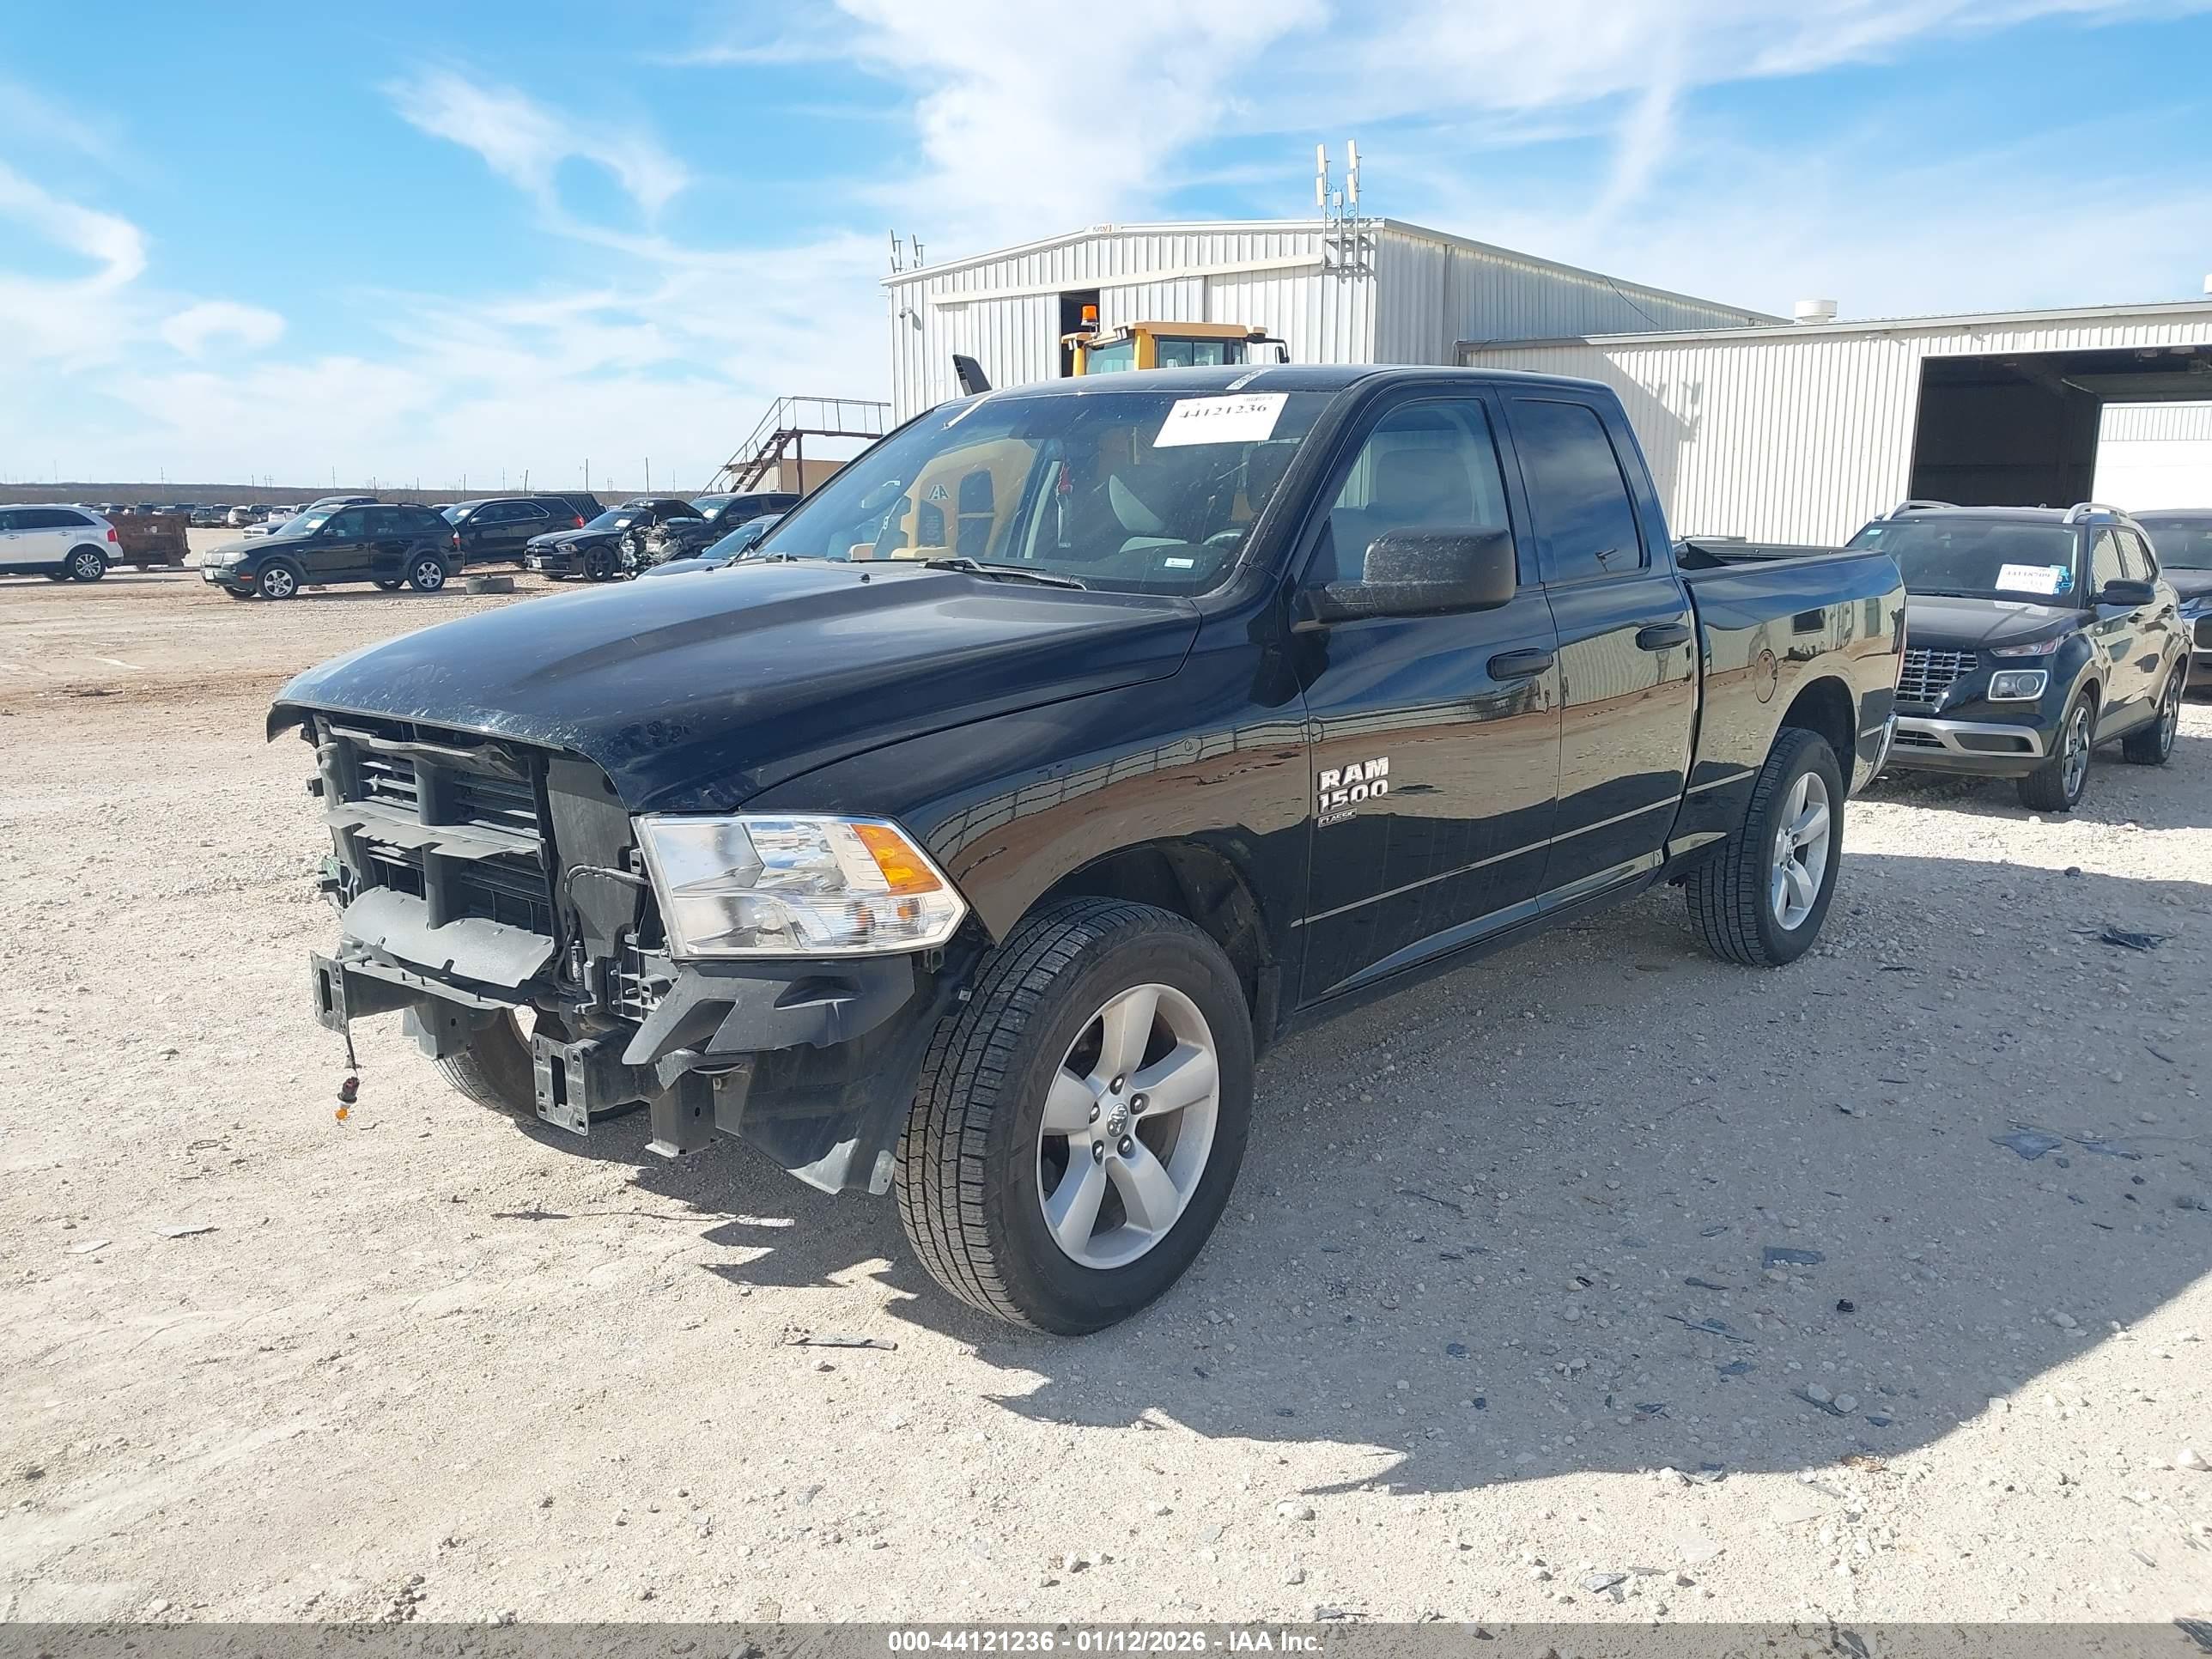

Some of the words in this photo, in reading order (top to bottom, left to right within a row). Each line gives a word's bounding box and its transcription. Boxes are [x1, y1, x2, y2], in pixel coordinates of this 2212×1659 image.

[1179, 404, 1267, 419] 44121236
[1318, 757, 1389, 791] RAM
[1318, 780, 1389, 813] 1500
[1320, 810, 1356, 825] CLASSIC
